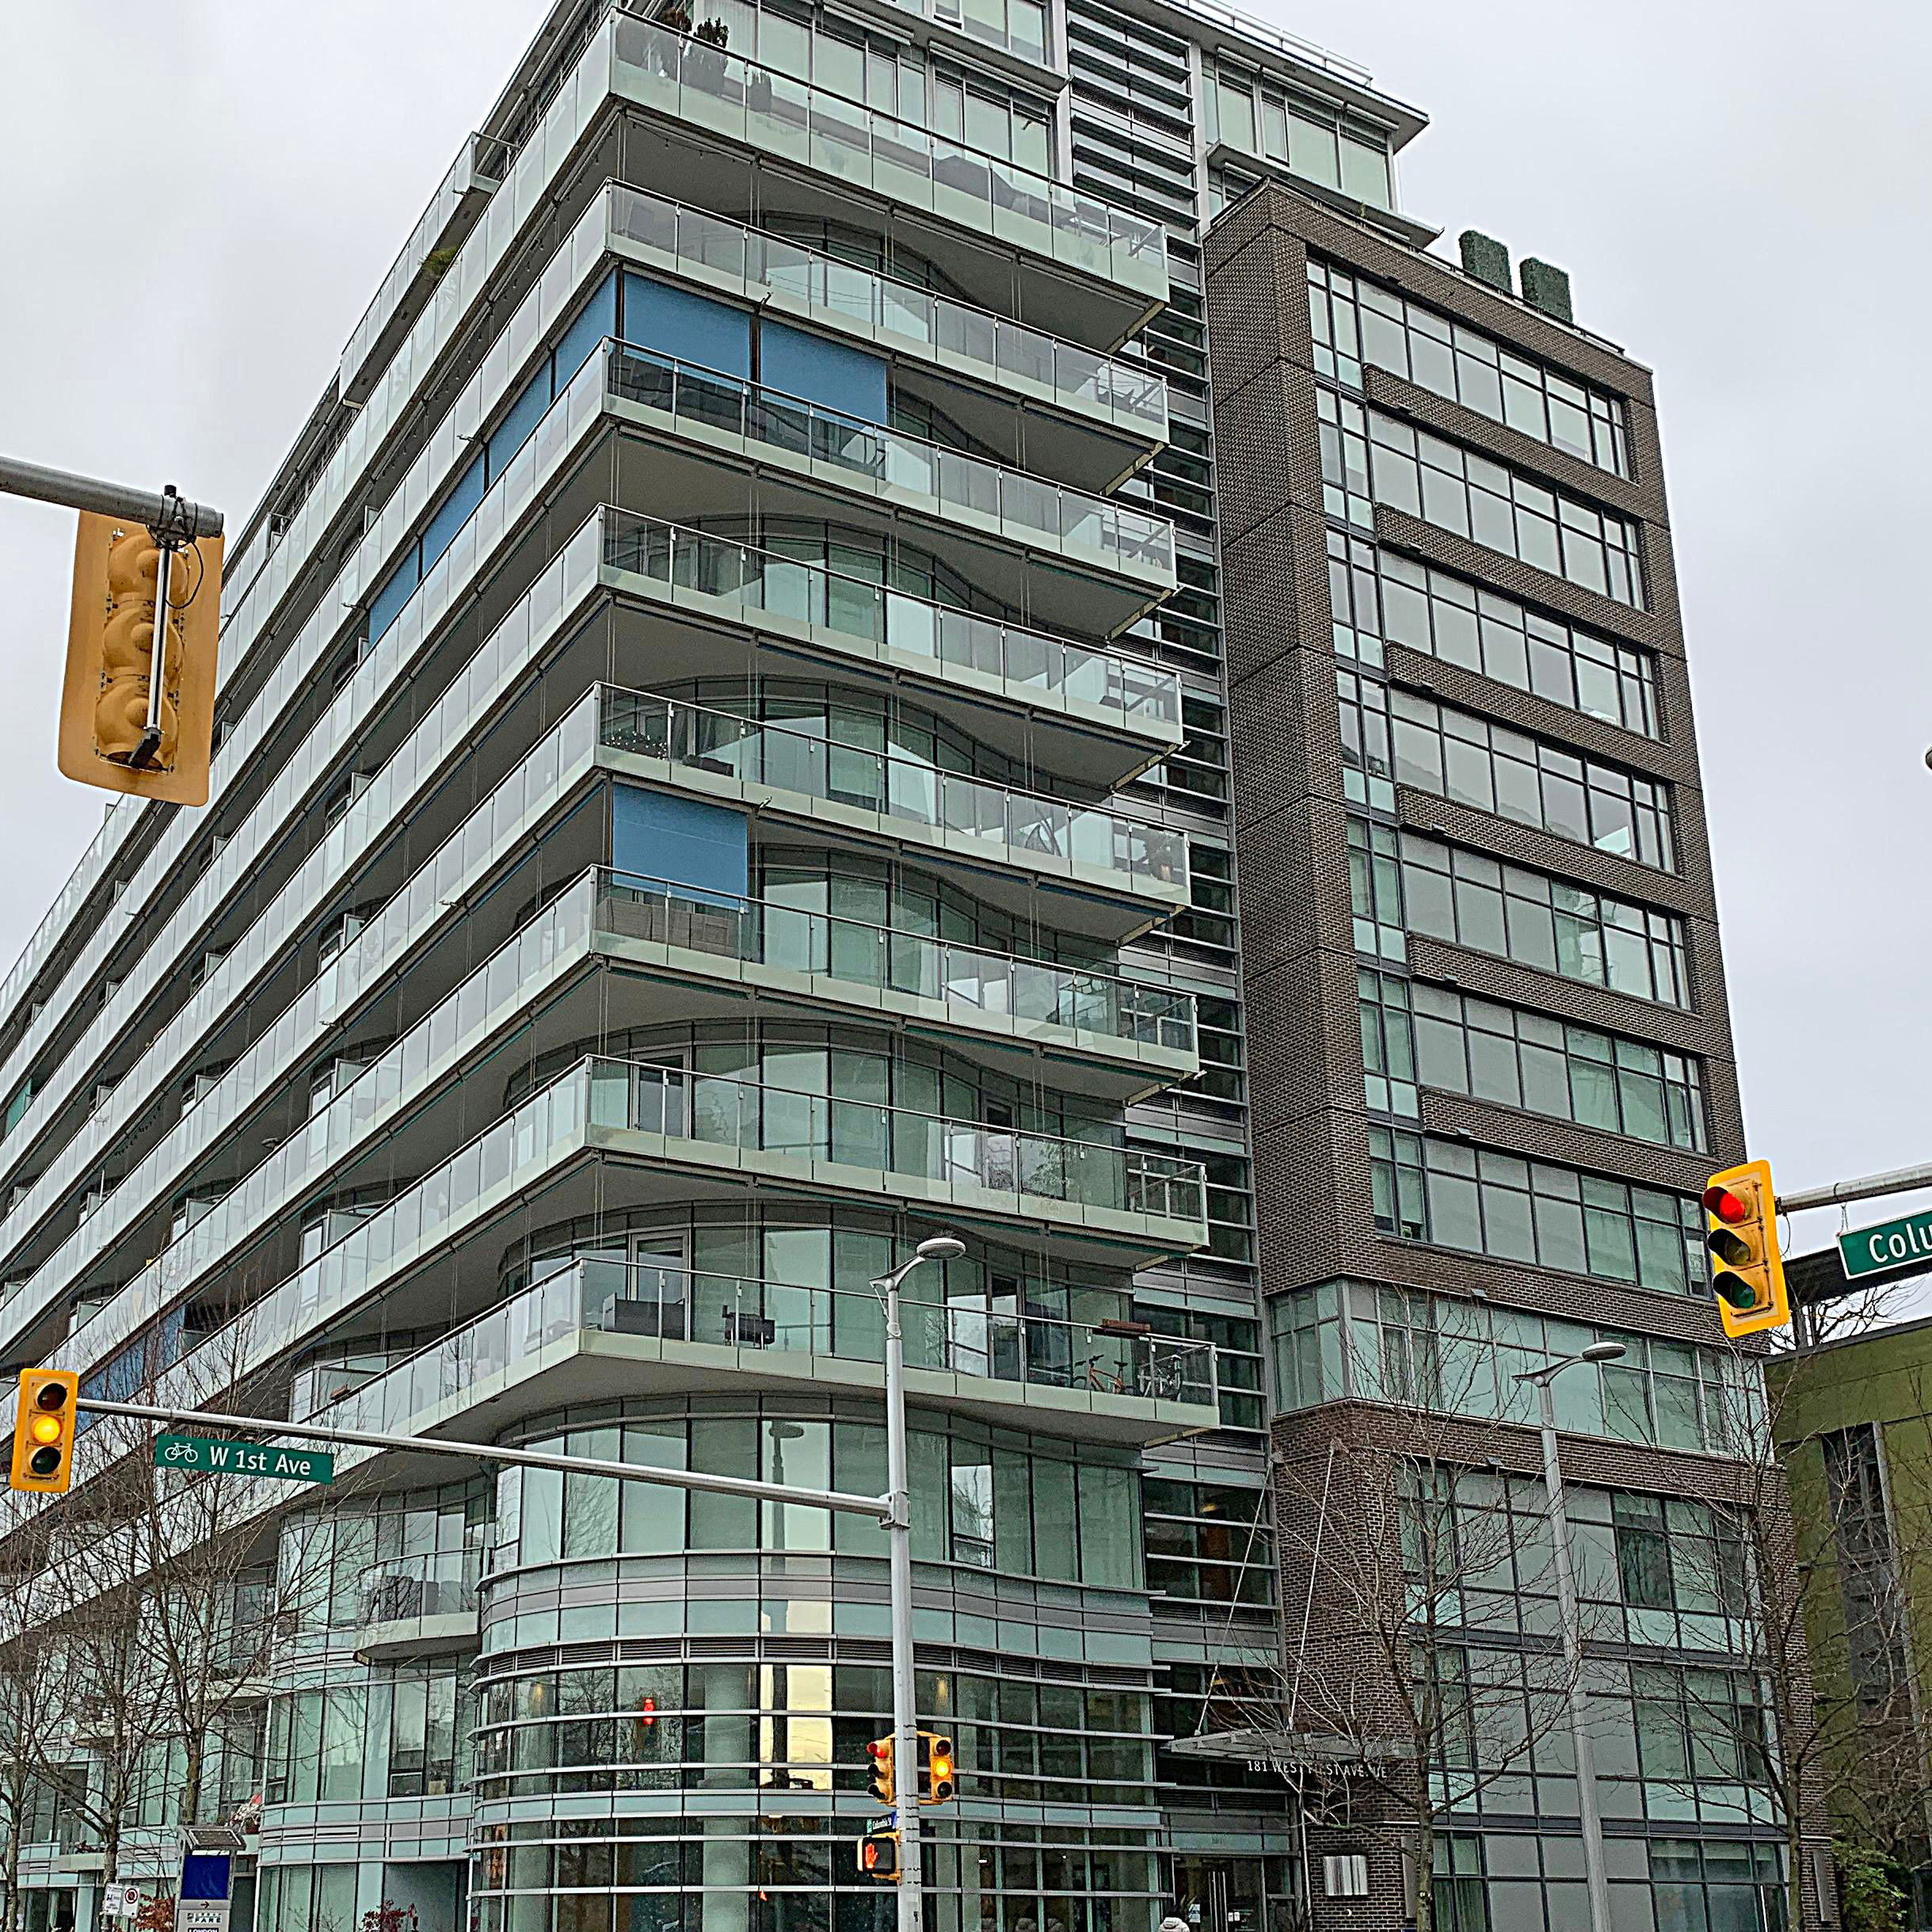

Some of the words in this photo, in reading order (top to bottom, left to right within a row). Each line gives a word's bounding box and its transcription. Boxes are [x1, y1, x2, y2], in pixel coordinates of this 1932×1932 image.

[210, 1446, 229, 1466] W
[235, 1450, 267, 1471] 1st
[274, 1454, 311, 1476] Ave
[1247, 1760, 1267, 1772] 181
